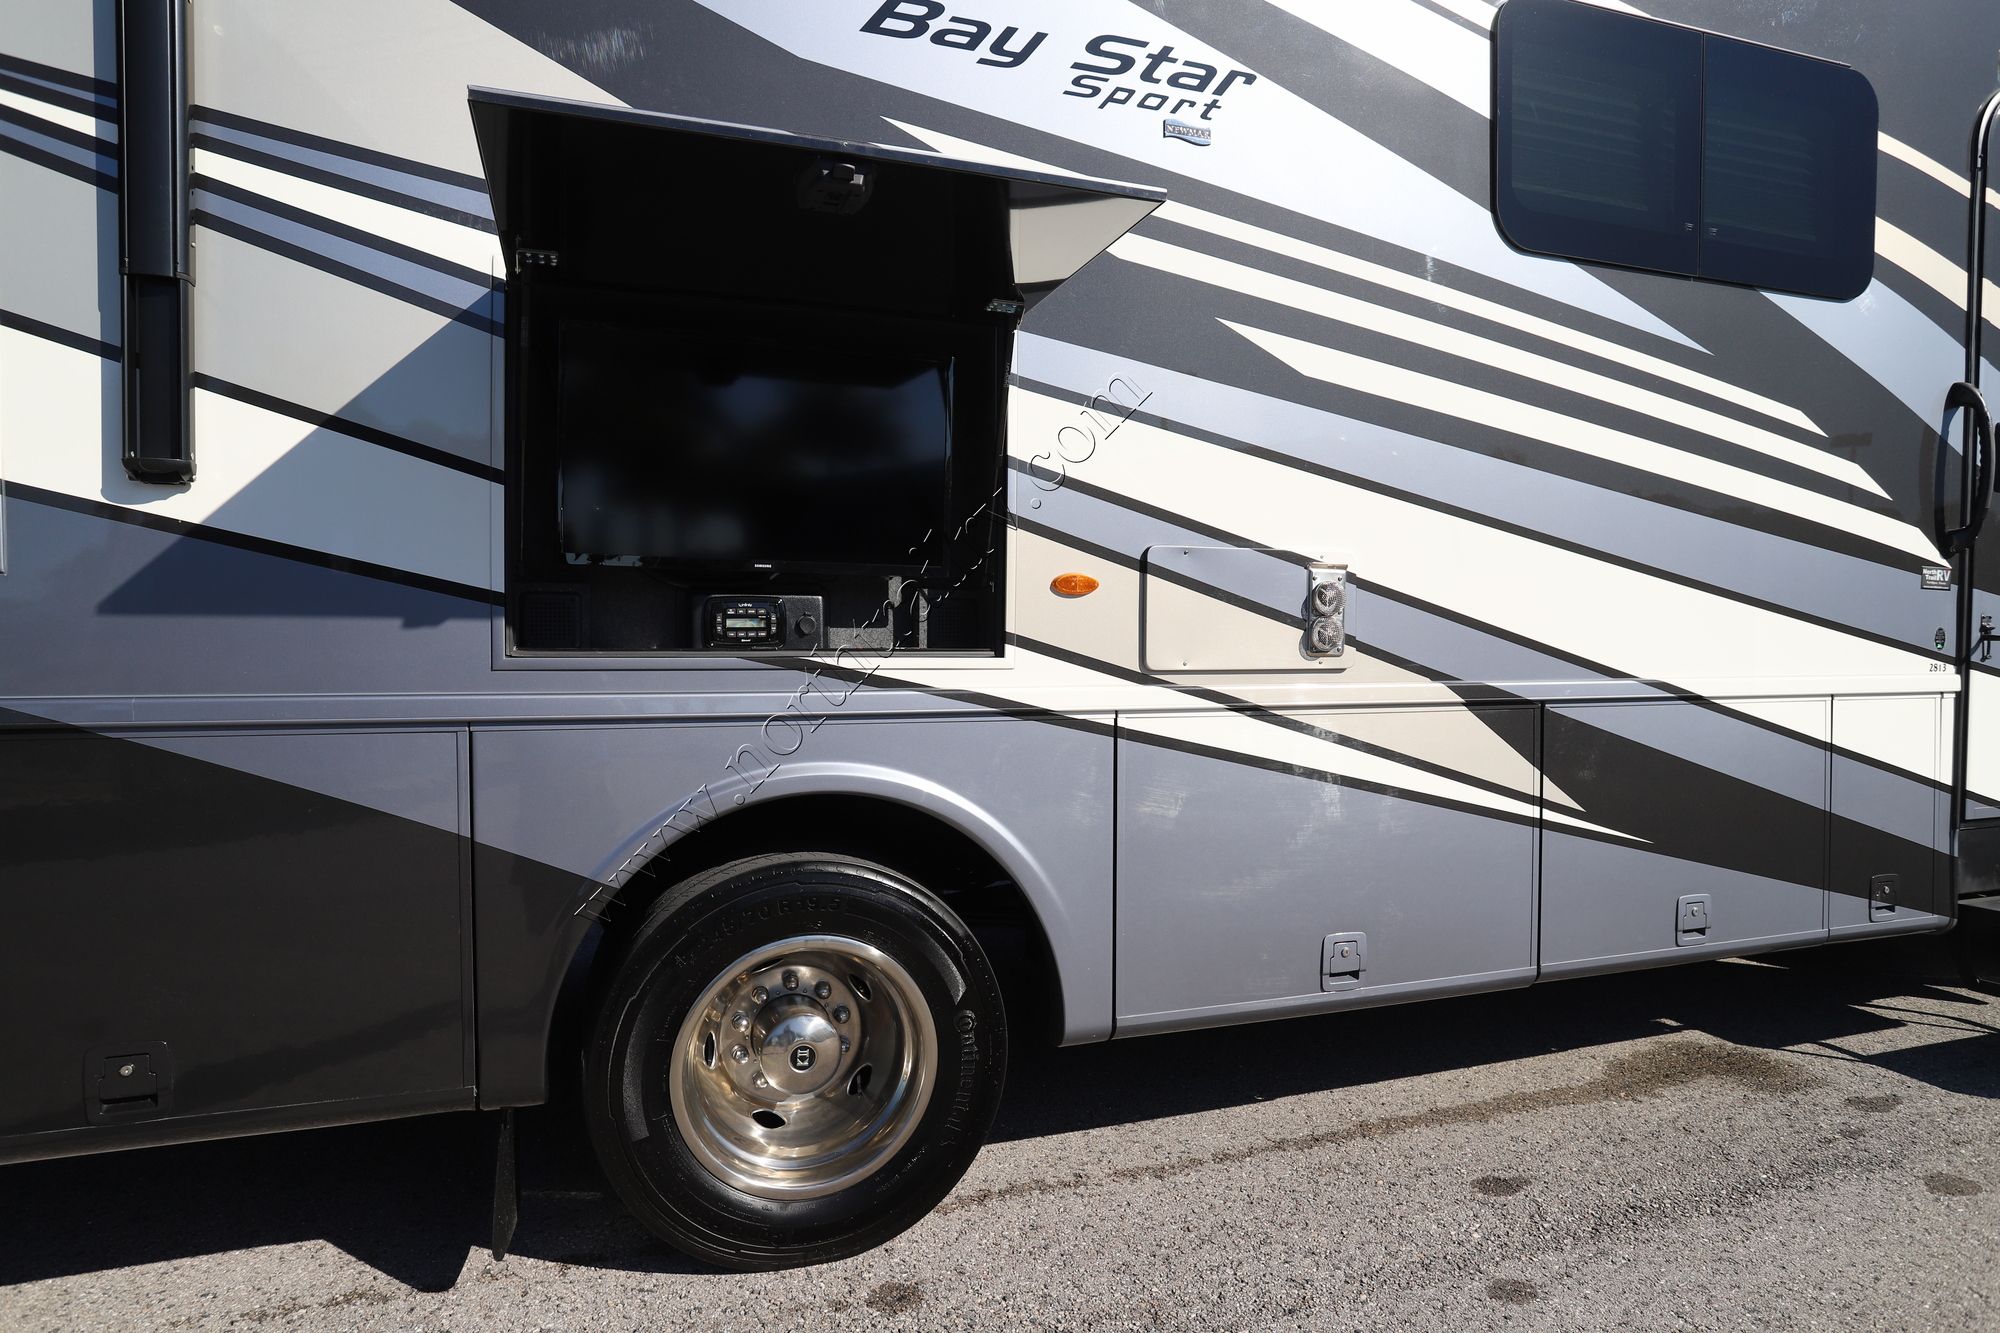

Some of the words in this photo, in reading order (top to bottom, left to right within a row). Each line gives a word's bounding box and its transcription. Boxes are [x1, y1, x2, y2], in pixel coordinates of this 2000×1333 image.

[859, 0, 1049, 68] Bay
[1070, 34, 1258, 96] Star
[1062, 75, 1222, 121] Sport
[1166, 125, 1211, 140] NEWMAR
[1937, 569, 1951, 581] RV
[1929, 663, 1947, 673] 2813
